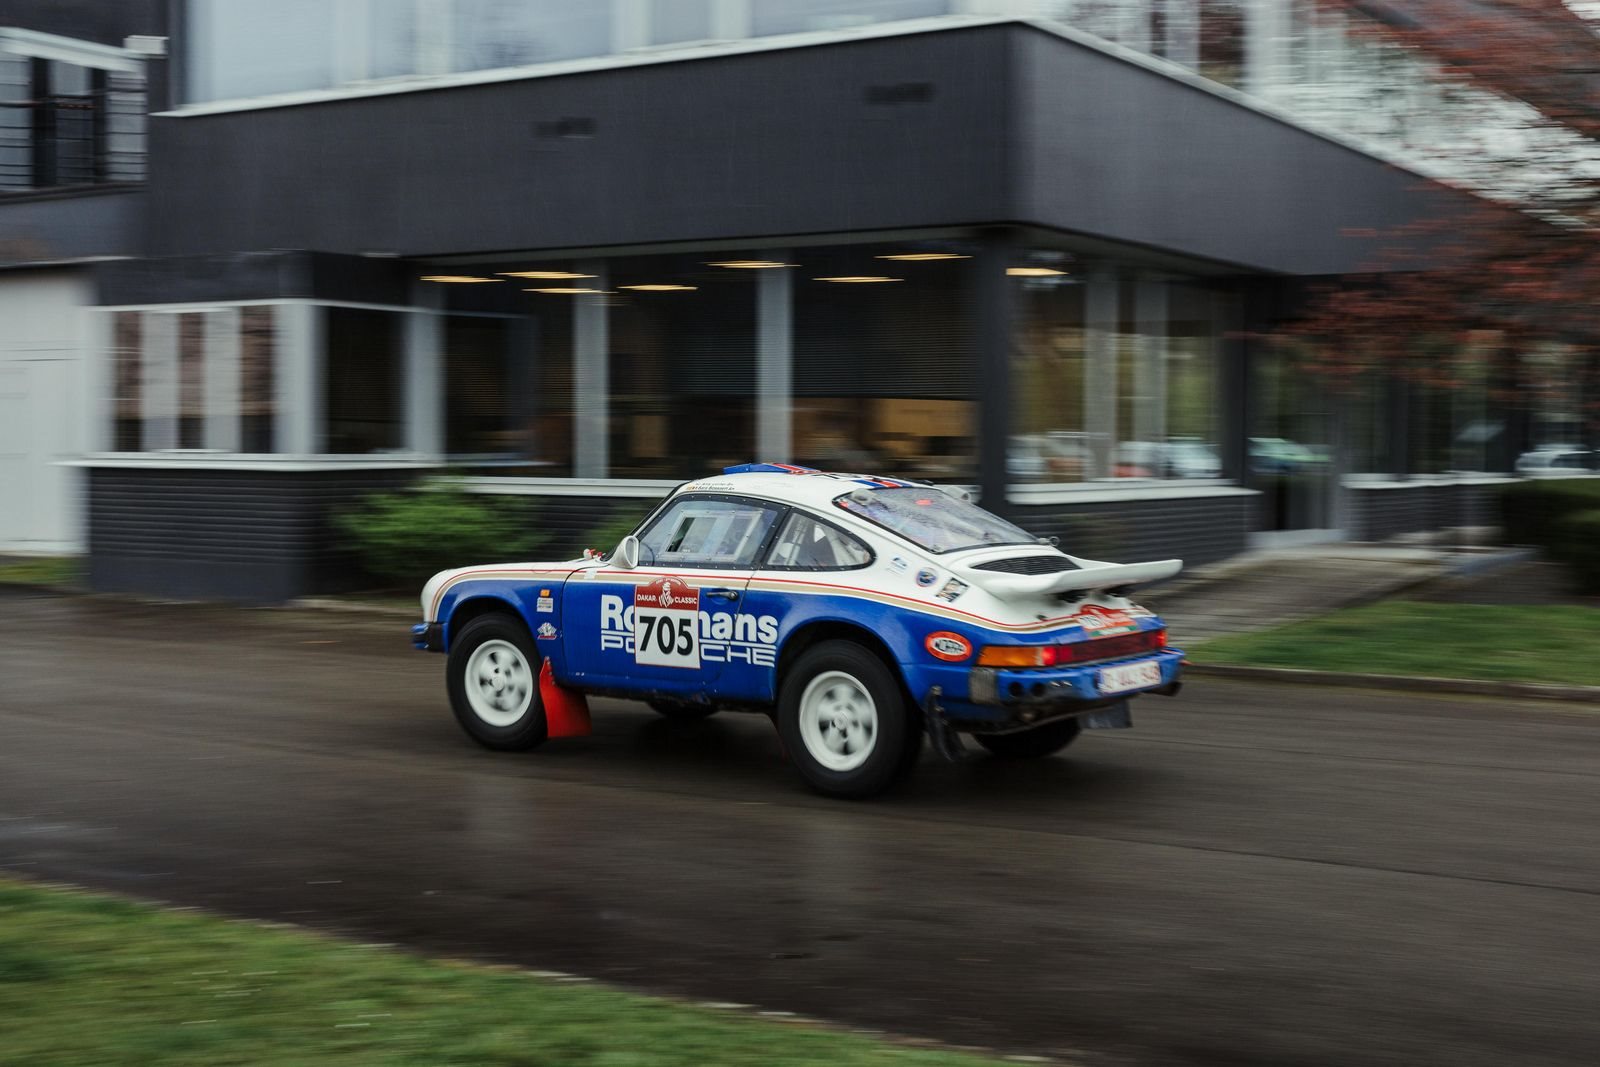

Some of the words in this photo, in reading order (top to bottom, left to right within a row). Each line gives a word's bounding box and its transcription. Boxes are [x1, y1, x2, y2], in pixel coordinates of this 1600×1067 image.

[637, 594, 657, 602] DAKAR
[674, 596, 698, 605] CLASSIC
[639, 615, 694, 656] 705
